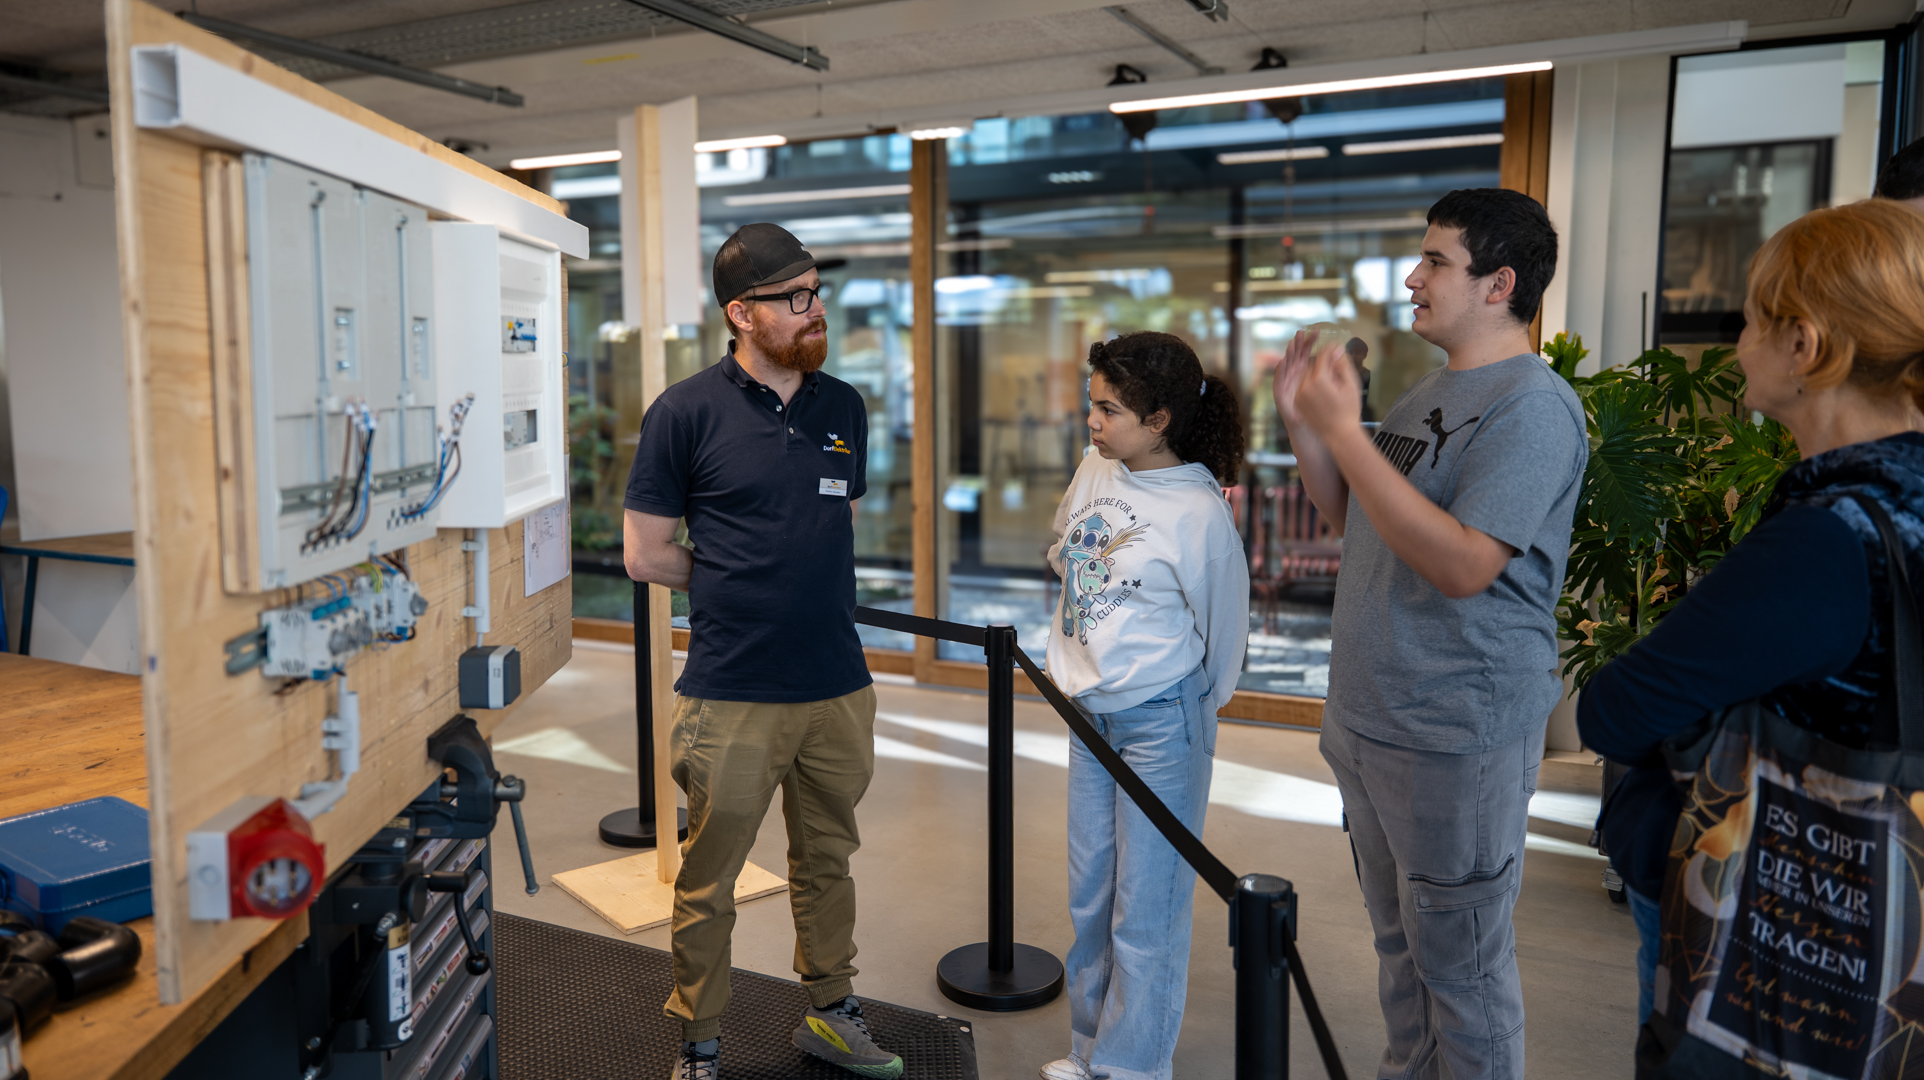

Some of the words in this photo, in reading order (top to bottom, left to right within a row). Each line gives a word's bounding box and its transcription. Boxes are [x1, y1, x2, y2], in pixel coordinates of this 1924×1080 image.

[1093, 497, 1116, 507] HERE
[1114, 499, 1132, 515] FOR
[1096, 588, 1132, 620] CUDDLES
[1765, 803, 1798, 838] ES
[1806, 823, 1877, 866] GIBT
[1757, 848, 1804, 889] DIE
[1809, 870, 1871, 916] WIR
[1748, 911, 1867, 984] TRAGEN!
[1735, 961, 1777, 994] Egal
[1760, 1008, 1806, 1034] und
